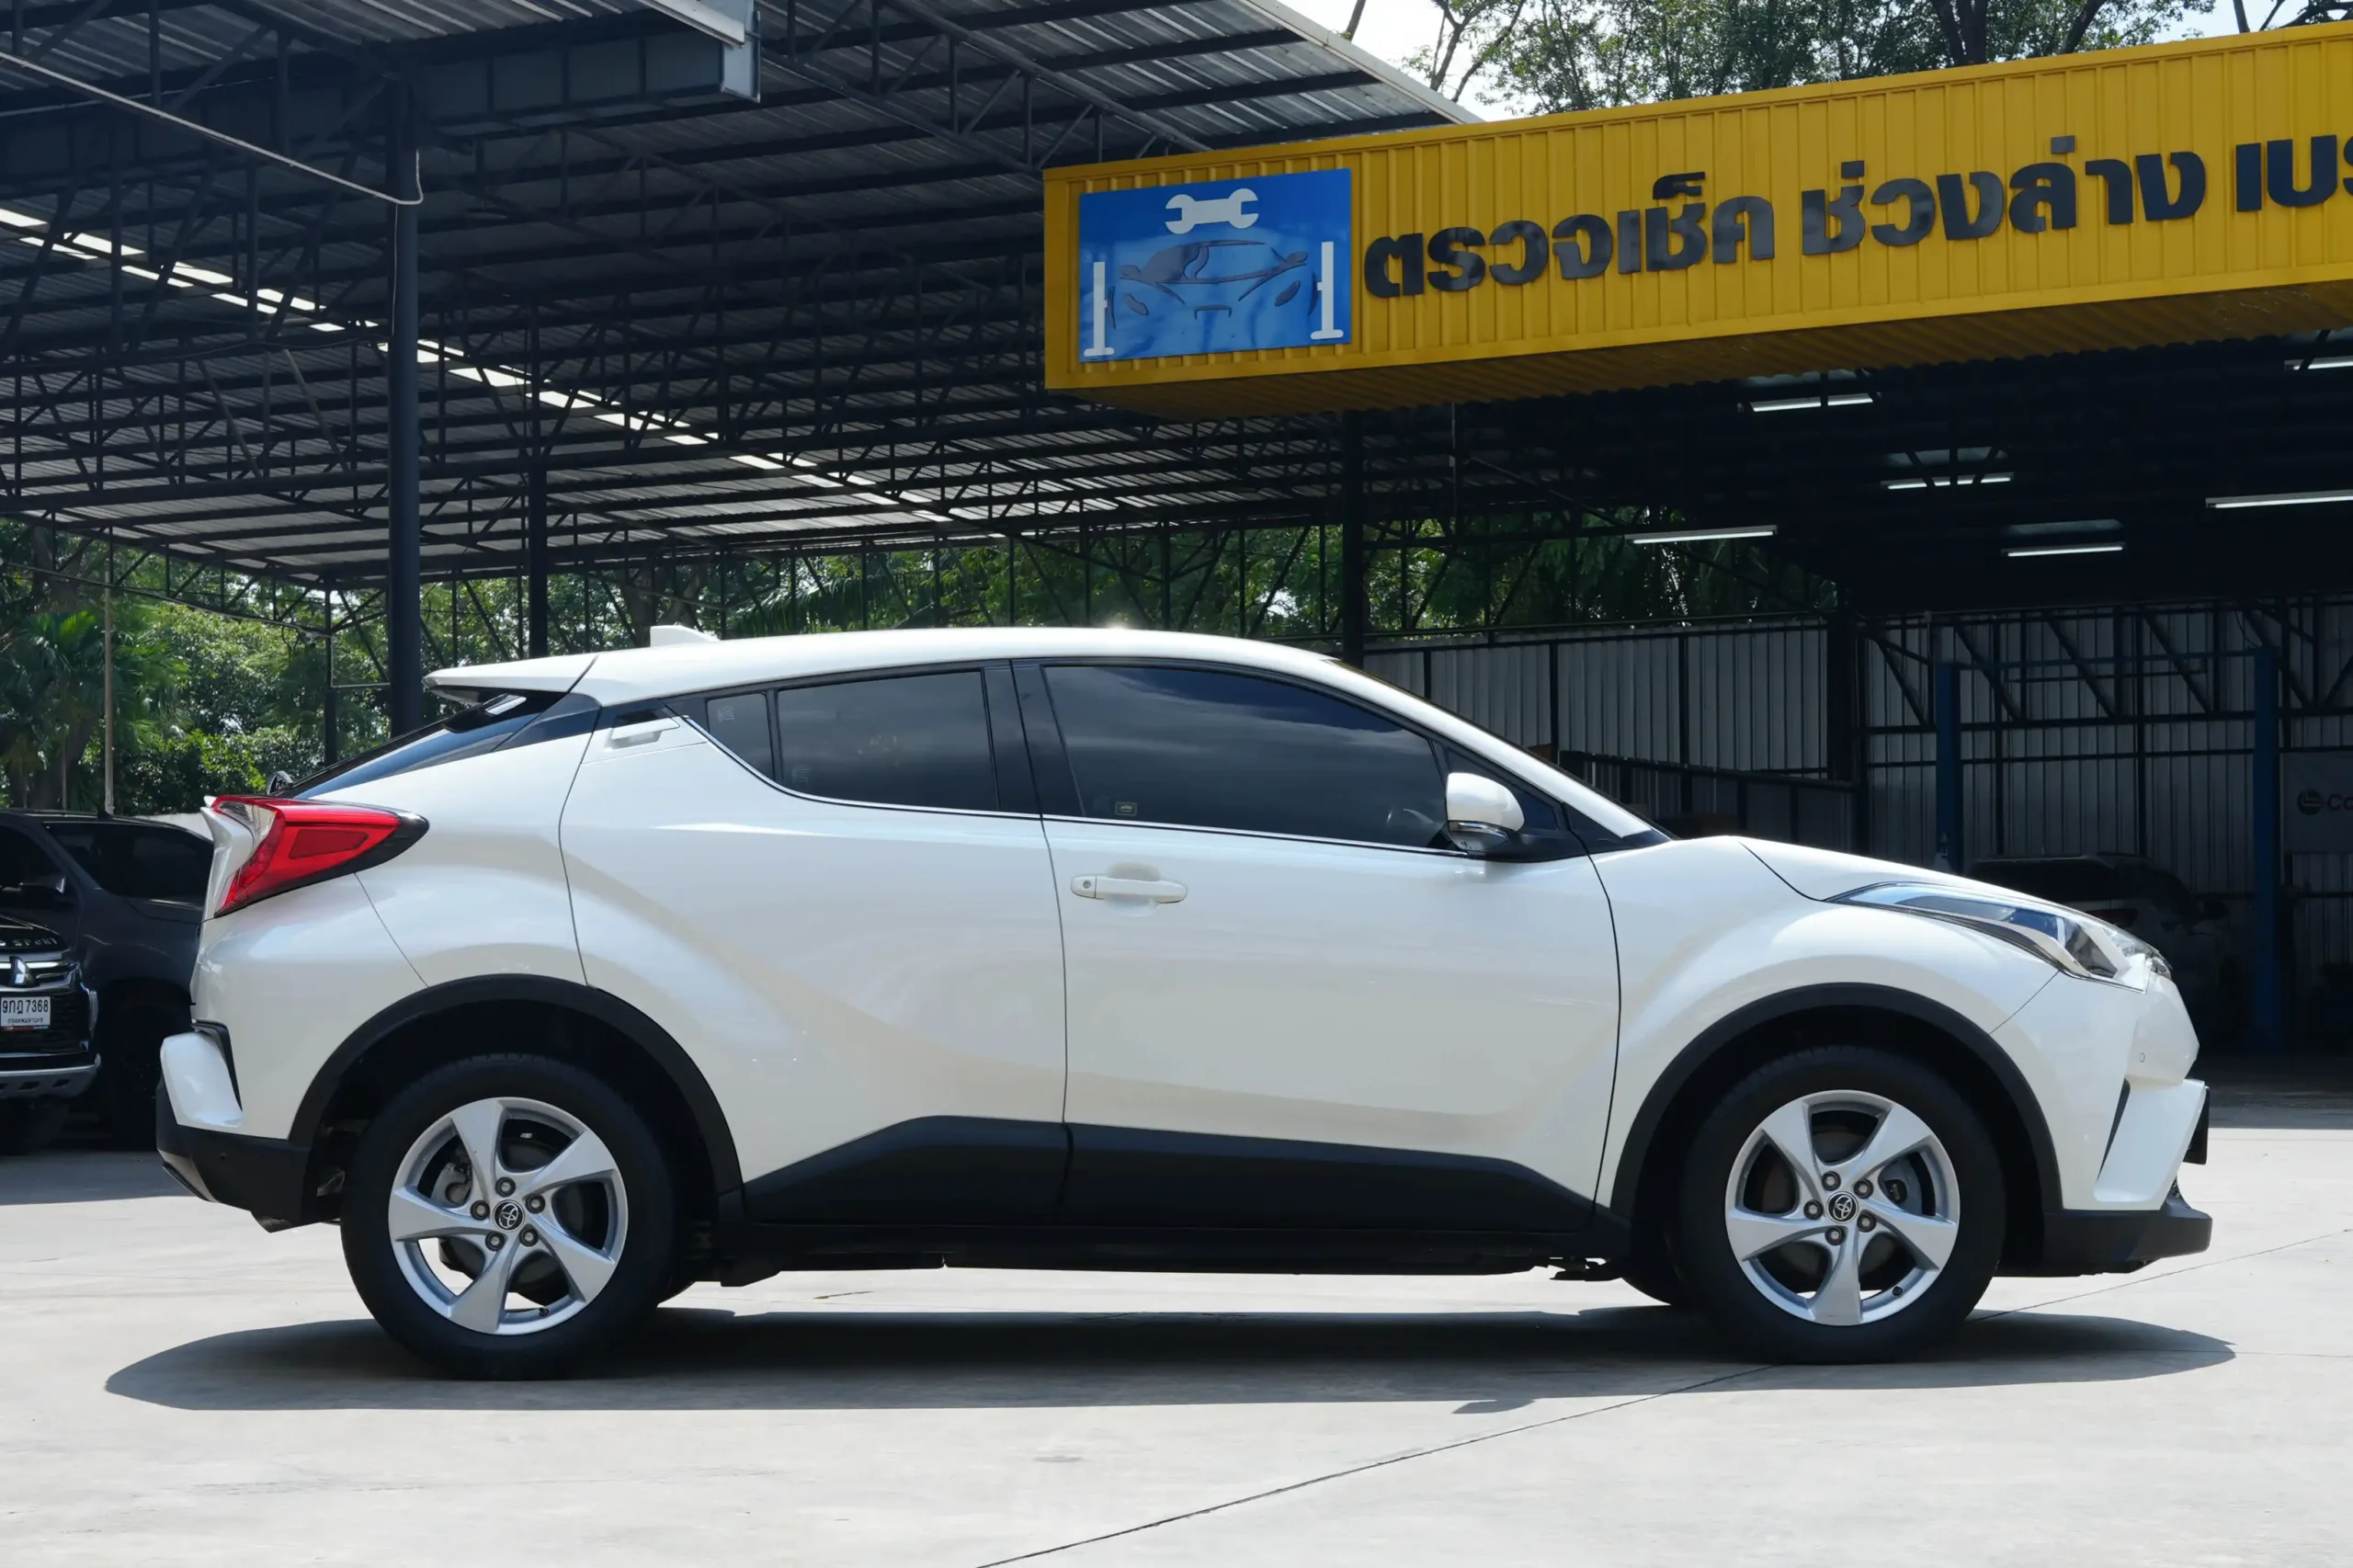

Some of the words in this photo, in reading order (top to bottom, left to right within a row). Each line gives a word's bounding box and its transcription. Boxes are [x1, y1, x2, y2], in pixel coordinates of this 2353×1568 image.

[1364, 171, 1775, 299] ตรวจเช็ค
[1801, 134, 2207, 256] ช่วงล่าง
[2235, 133, 2353, 213] เบ
[26, 999, 49, 1013] 7368
